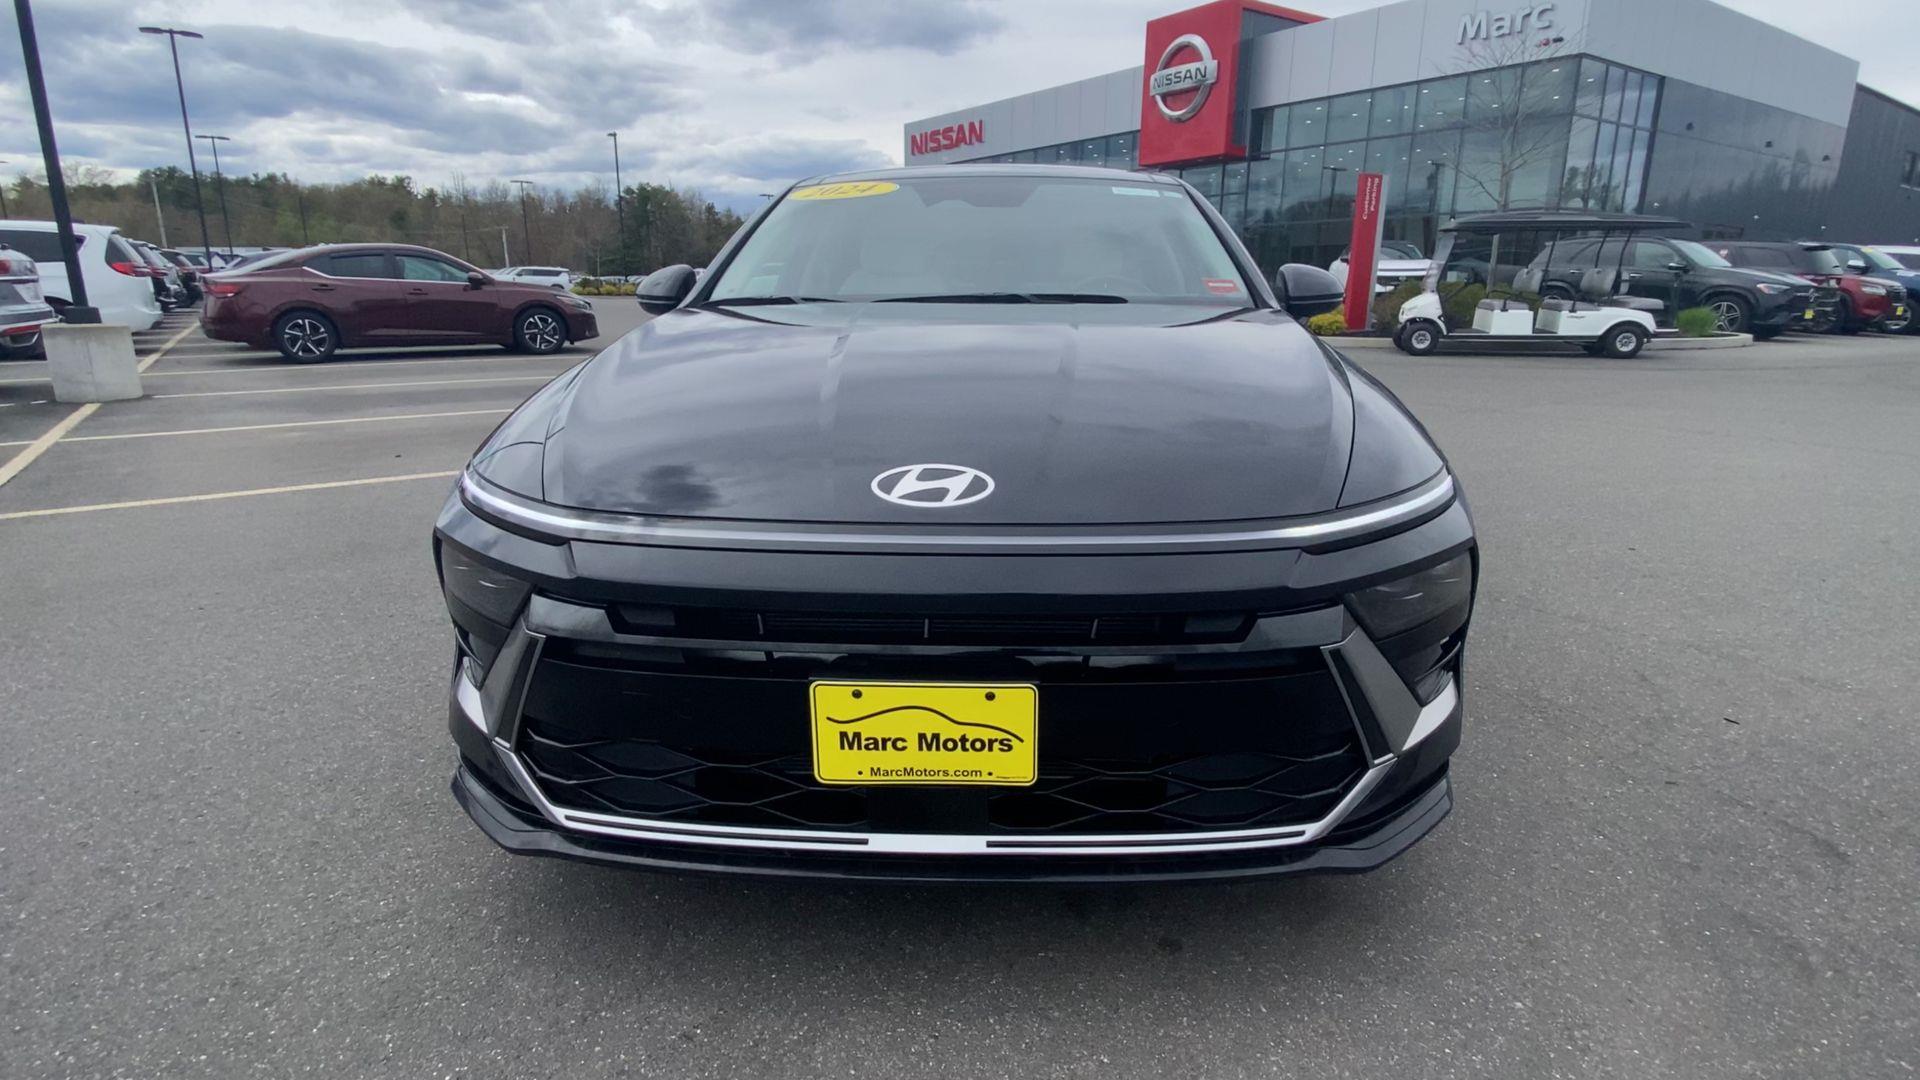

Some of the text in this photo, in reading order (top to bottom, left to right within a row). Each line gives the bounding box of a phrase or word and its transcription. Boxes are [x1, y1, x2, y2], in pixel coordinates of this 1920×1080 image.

[1457, 2, 1554, 45] Marc
[1153, 65, 1207, 89] NISSAN
[911, 119, 984, 156] NISSAN
[1362, 177, 1371, 220] Customer
[839, 731, 1014, 753] Marc Motors
[870, 767, 983, 778] MarcMotors.com
